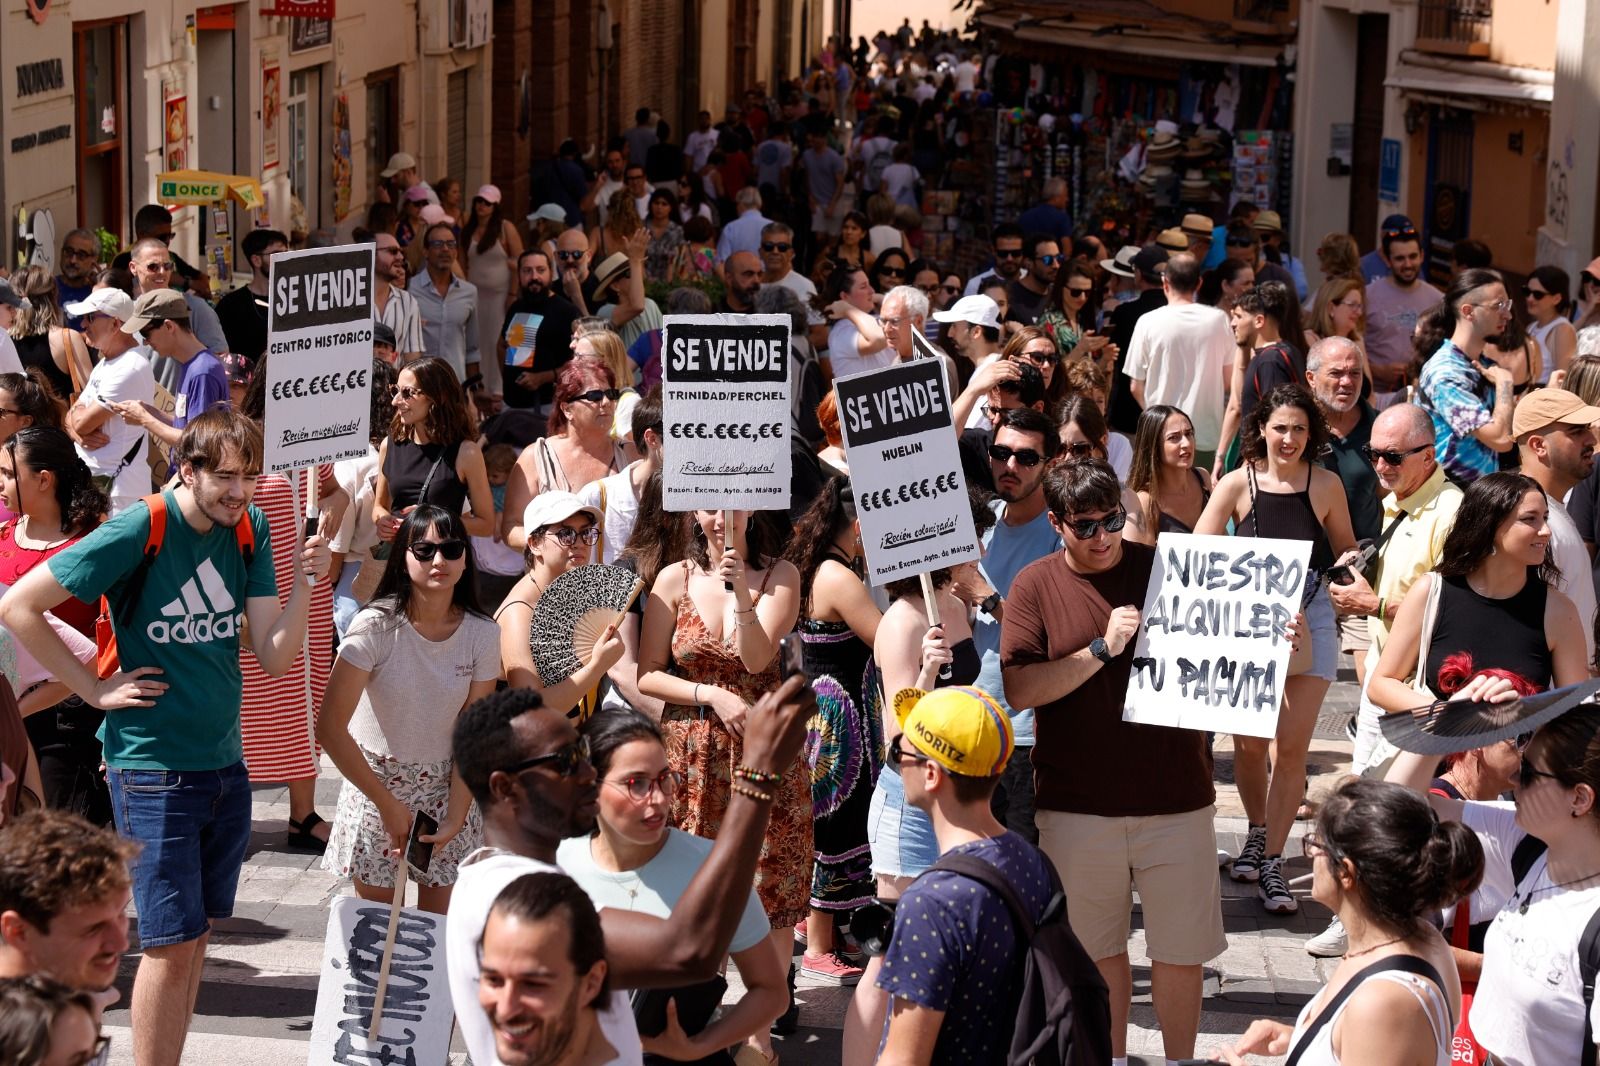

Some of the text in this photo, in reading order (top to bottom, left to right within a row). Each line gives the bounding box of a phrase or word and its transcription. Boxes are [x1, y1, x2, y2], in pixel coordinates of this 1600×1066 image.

[179, 184, 218, 196] ONCE
[275, 267, 367, 316] SE VENDE
[270, 330, 372, 355] CENTRO HISTORICO
[672, 337, 782, 372] SE VENDE
[271, 369, 367, 401] €€€.€€€,€€
[668, 390, 786, 401] TRINIDAD/PERCHEL
[846, 378, 943, 433] SE VENDE
[277, 427, 309, 449] ¡Recién
[669, 422, 783, 442] €€€.€€€,€€
[293, 458, 317, 467] Excmo.
[335, 451, 343, 459] de
[344, 448, 367, 457] Málaga
[881, 441, 923, 462] HUELIN
[680, 461, 715, 473] ¡Recién
[694, 486, 722, 494] Excmo.
[723, 487, 742, 495] Ayto.
[755, 486, 782, 495] Málaga
[860, 471, 959, 512] €€€.€€€,€€
[879, 514, 958, 549] ¡Recién colonizado!
[898, 559, 923, 569] Excmo.
[923, 553, 941, 563] Ayto.
[941, 550, 949, 558] de
[950, 543, 975, 555] Málaga
[1166, 547, 1303, 598] NUESTRO
[1144, 594, 1293, 646] ALQUILER
[1132, 656, 1277, 712] TU PAGUITA
[914, 720, 966, 763] MORITZ
